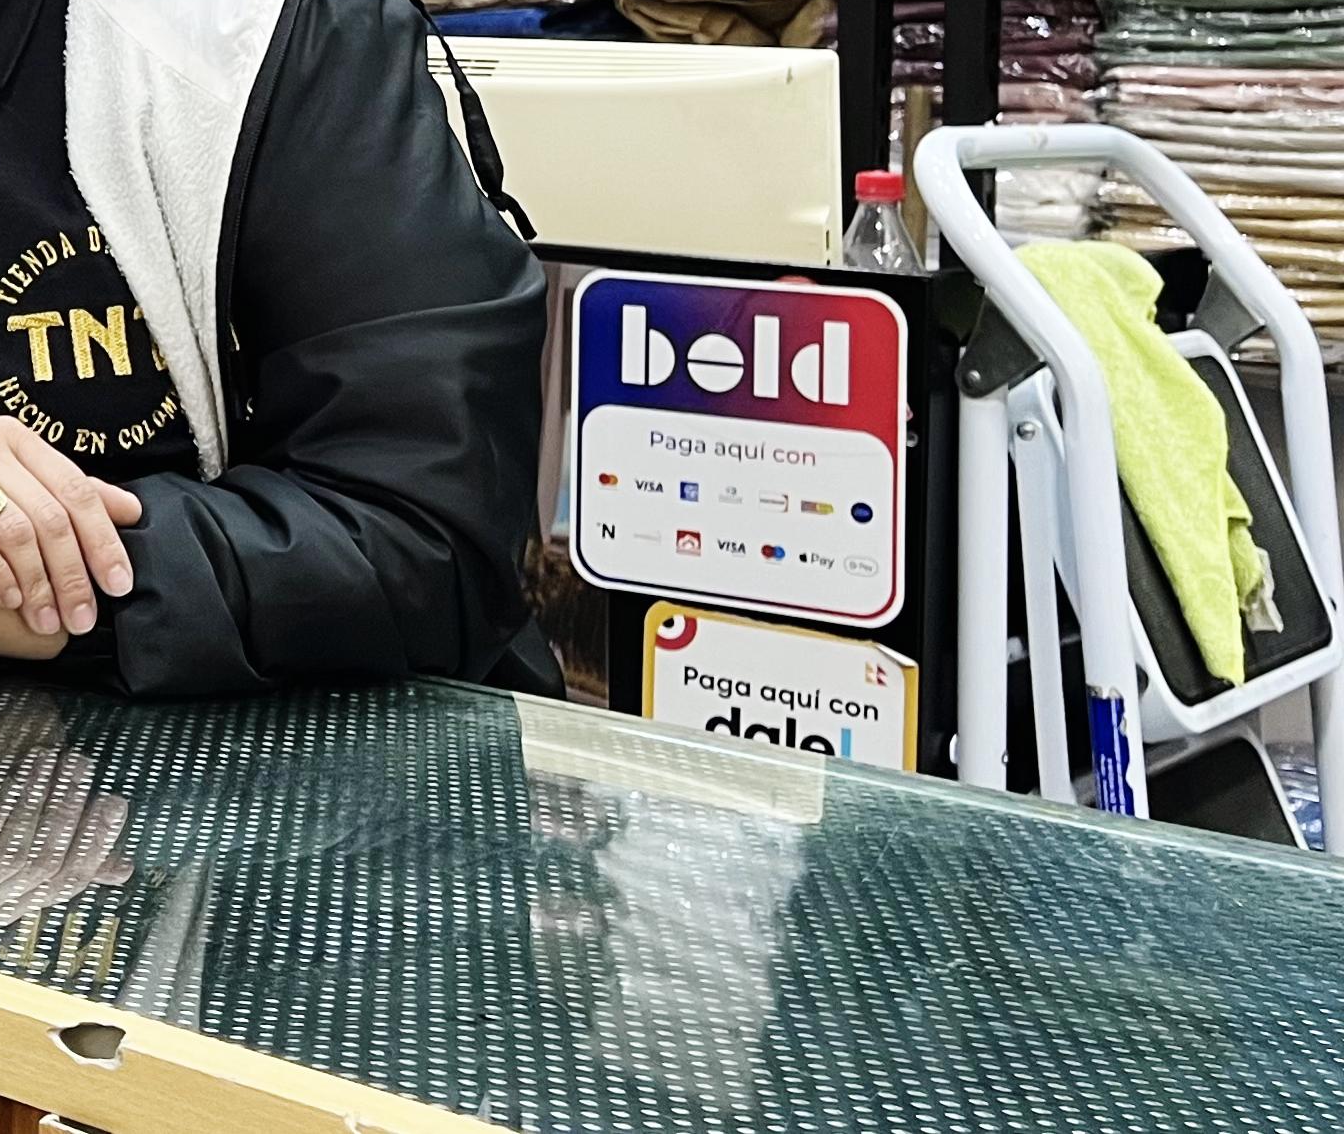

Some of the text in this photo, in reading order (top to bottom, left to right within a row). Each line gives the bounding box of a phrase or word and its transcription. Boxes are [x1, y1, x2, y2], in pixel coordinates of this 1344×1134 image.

[621, 304, 850, 406] bold
[74, 428, 108, 454] EN
[118, 391, 179, 451] COLOM
[650, 430, 816, 466] Paga aquí con
[635, 479, 664, 493] VISA
[717, 539, 746, 555] VISA
[811, 553, 835, 570] Pay
[684, 665, 879, 722] Paga aquí con
